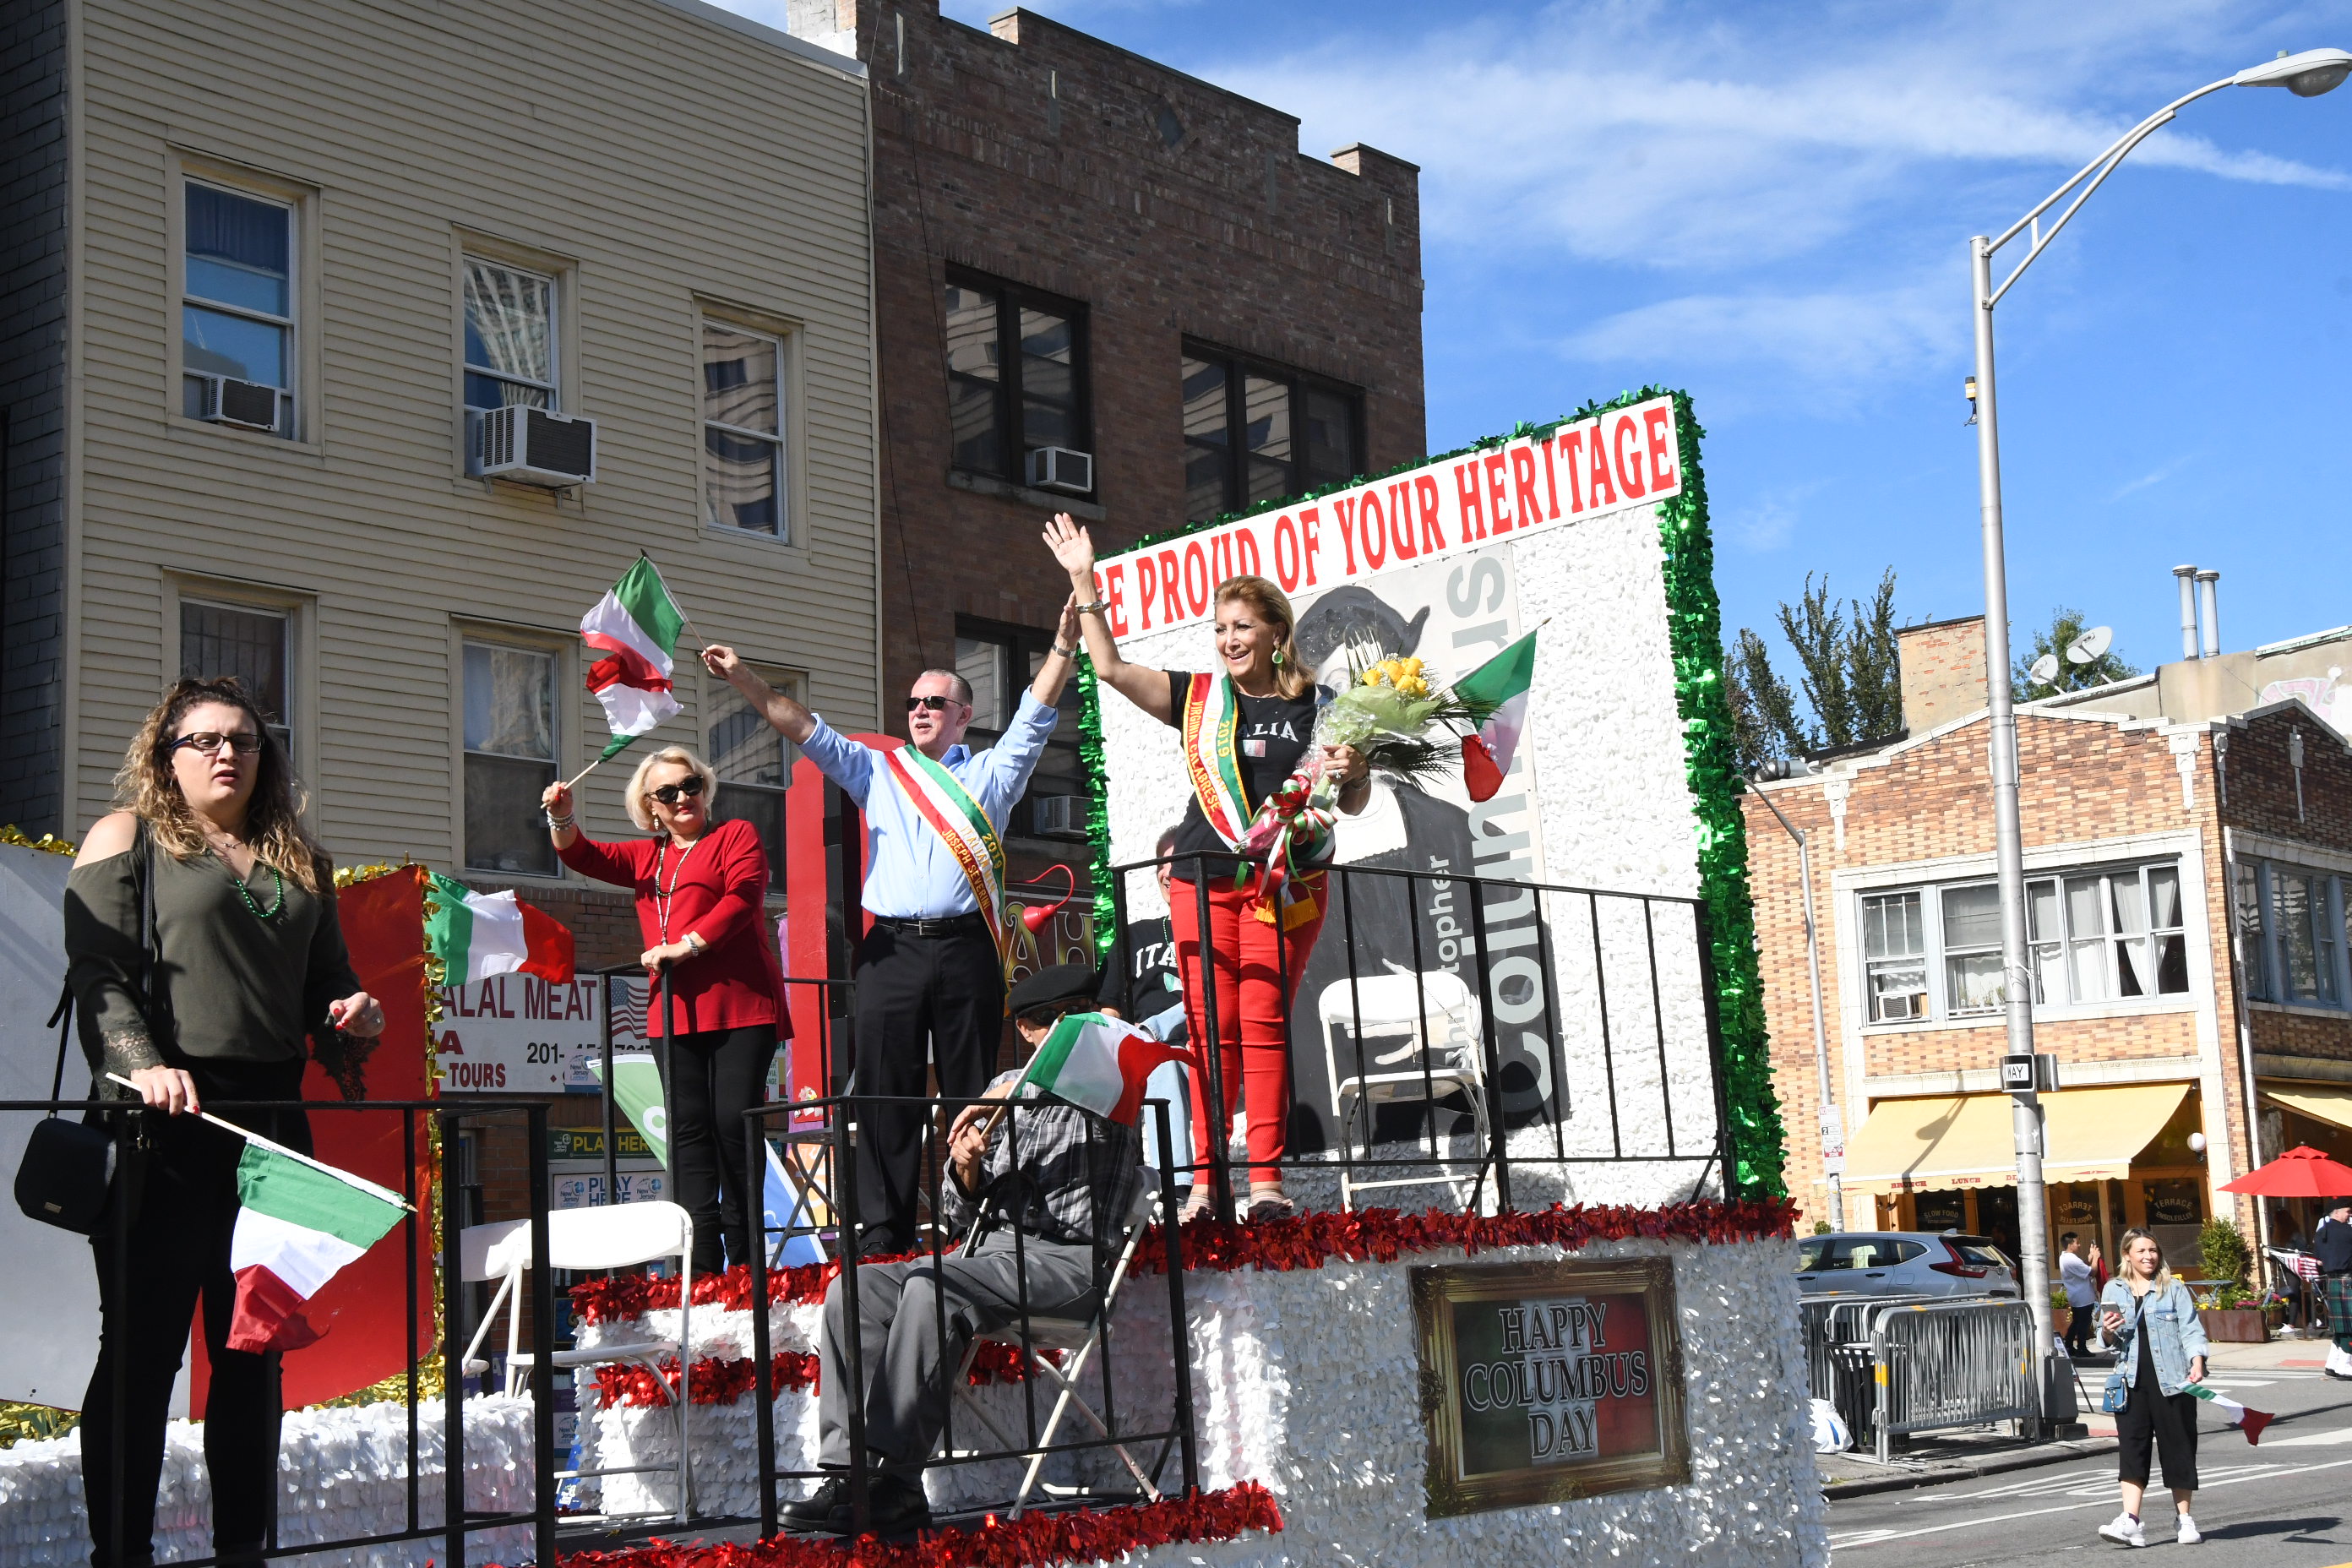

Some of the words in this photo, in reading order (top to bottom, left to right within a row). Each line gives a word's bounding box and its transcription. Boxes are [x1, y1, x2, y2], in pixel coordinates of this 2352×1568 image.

[1094, 564, 1129, 638] E
[1136, 529, 1261, 630] PROUD
[1274, 508, 1320, 593] OF
[1333, 475, 1447, 576] YOUR
[1454, 406, 1675, 545] HERITAGE
[1187, 700, 1204, 743] VIRGINIA
[1217, 720, 1231, 758] 2019
[1237, 721, 1299, 743] ALIA
[1189, 744, 1222, 813] CALABRESE
[960, 825, 990, 870] ITALIAN
[982, 833, 1003, 869] 2019
[941, 829, 972, 865] JOSEPH
[968, 864, 991, 910] SEVERINI
[1135, 941, 1179, 979] ITA
[525, 977, 597, 1021] MEAT
[449, 1062, 506, 1088] TOURS
[2007, 1064, 2023, 1079] WAY
[574, 1135, 605, 1152] PLA
[618, 1135, 649, 1152] HER
[1891, 1180, 1927, 1189] BRUNCH
[1952, 1177, 1981, 1185] LUNCH
[1924, 1209, 1941, 1219] SLOW
[1942, 1209, 1960, 1218] FOOD
[2153, 1197, 2193, 1210] TERRACE
[1499, 1302, 1607, 1355] HAPPY
[1464, 1350, 1649, 1412] COLUMBUS
[1528, 1407, 1598, 1459] DAY
